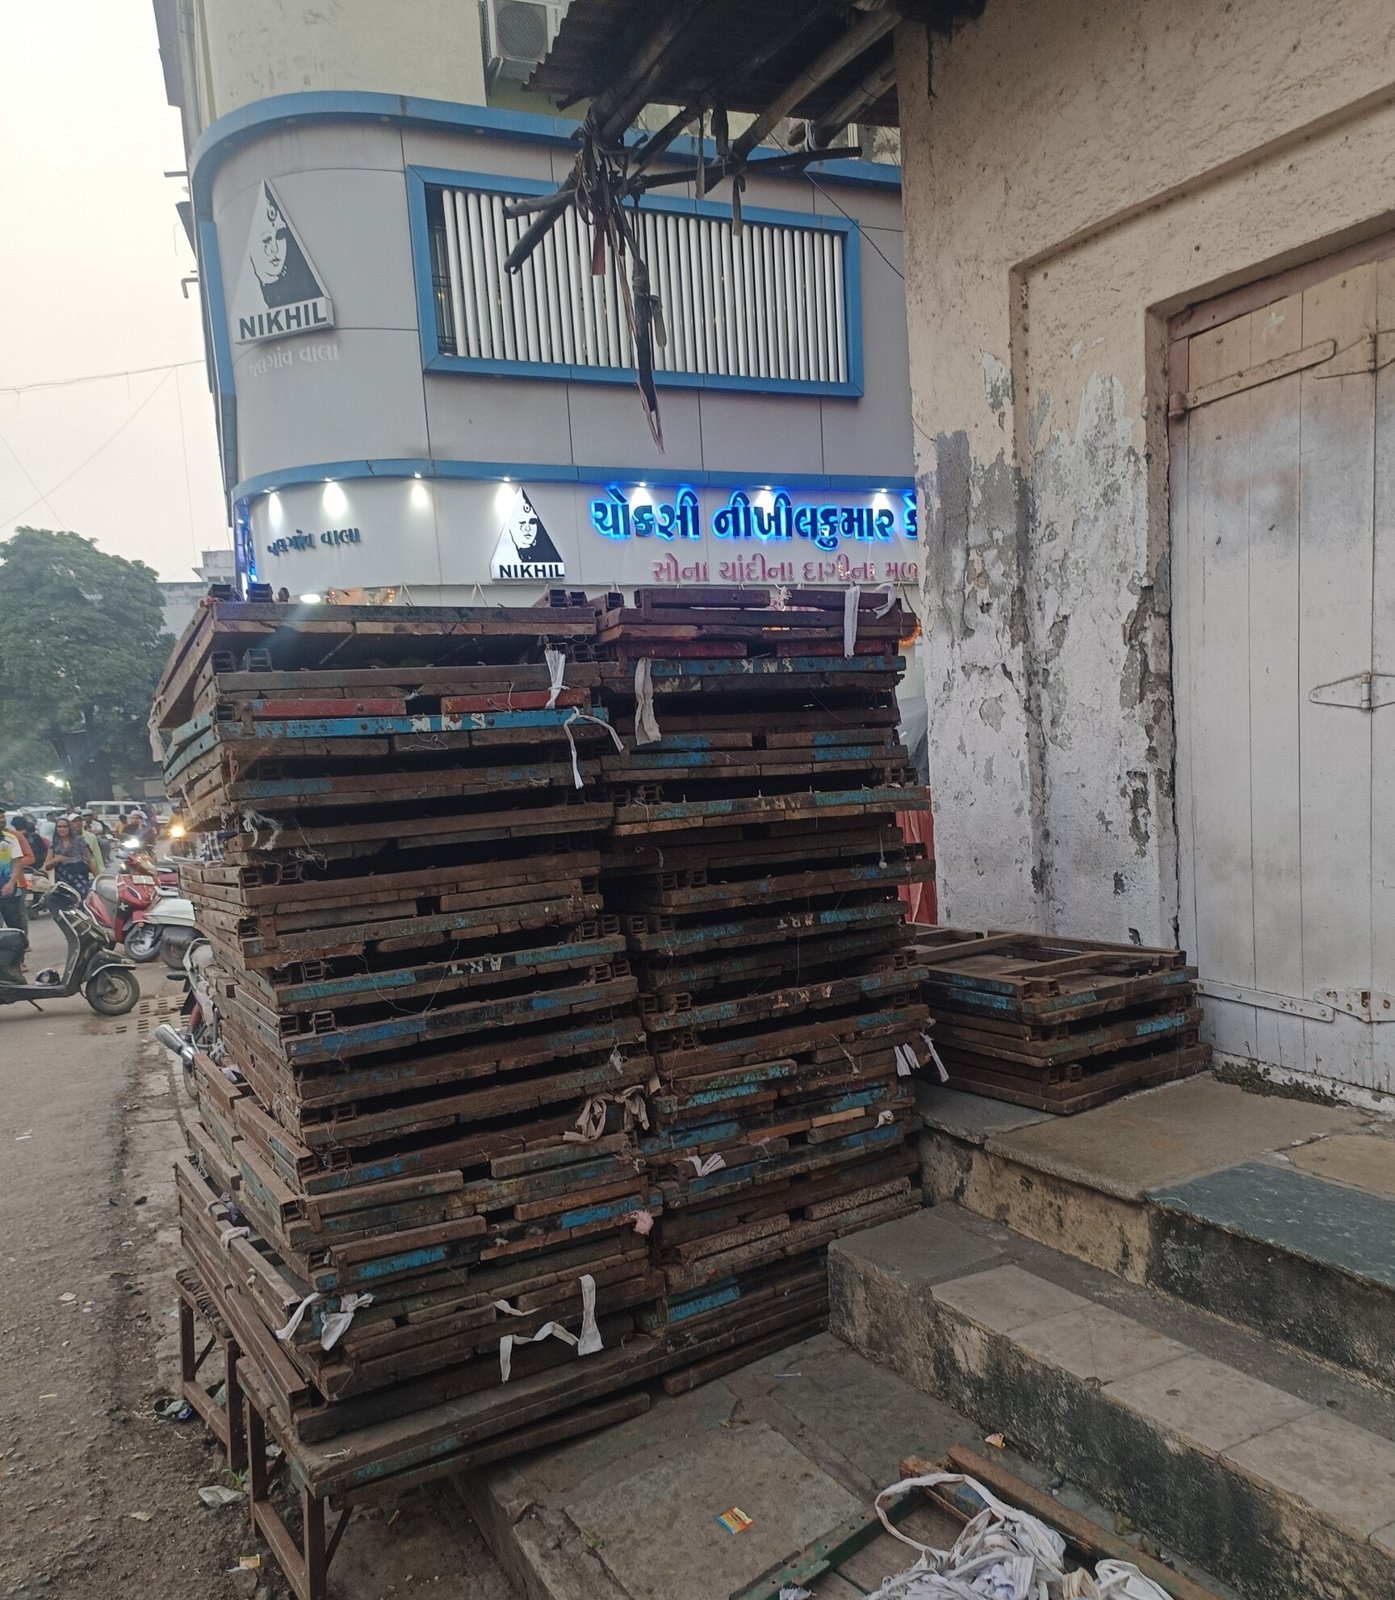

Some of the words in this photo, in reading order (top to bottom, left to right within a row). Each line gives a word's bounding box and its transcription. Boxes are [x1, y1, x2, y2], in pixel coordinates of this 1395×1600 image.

[239, 302, 327, 340] NIKHIL
[300, 344, 339, 362] વાલા
[591, 485, 701, 541] ચોકસી
[712, 490, 895, 550] નીખીલકુમાર
[499, 564, 566, 578] NIKHIL
[652, 552, 710, 583] સોના
[719, 552, 795, 583] ચાંદીના
